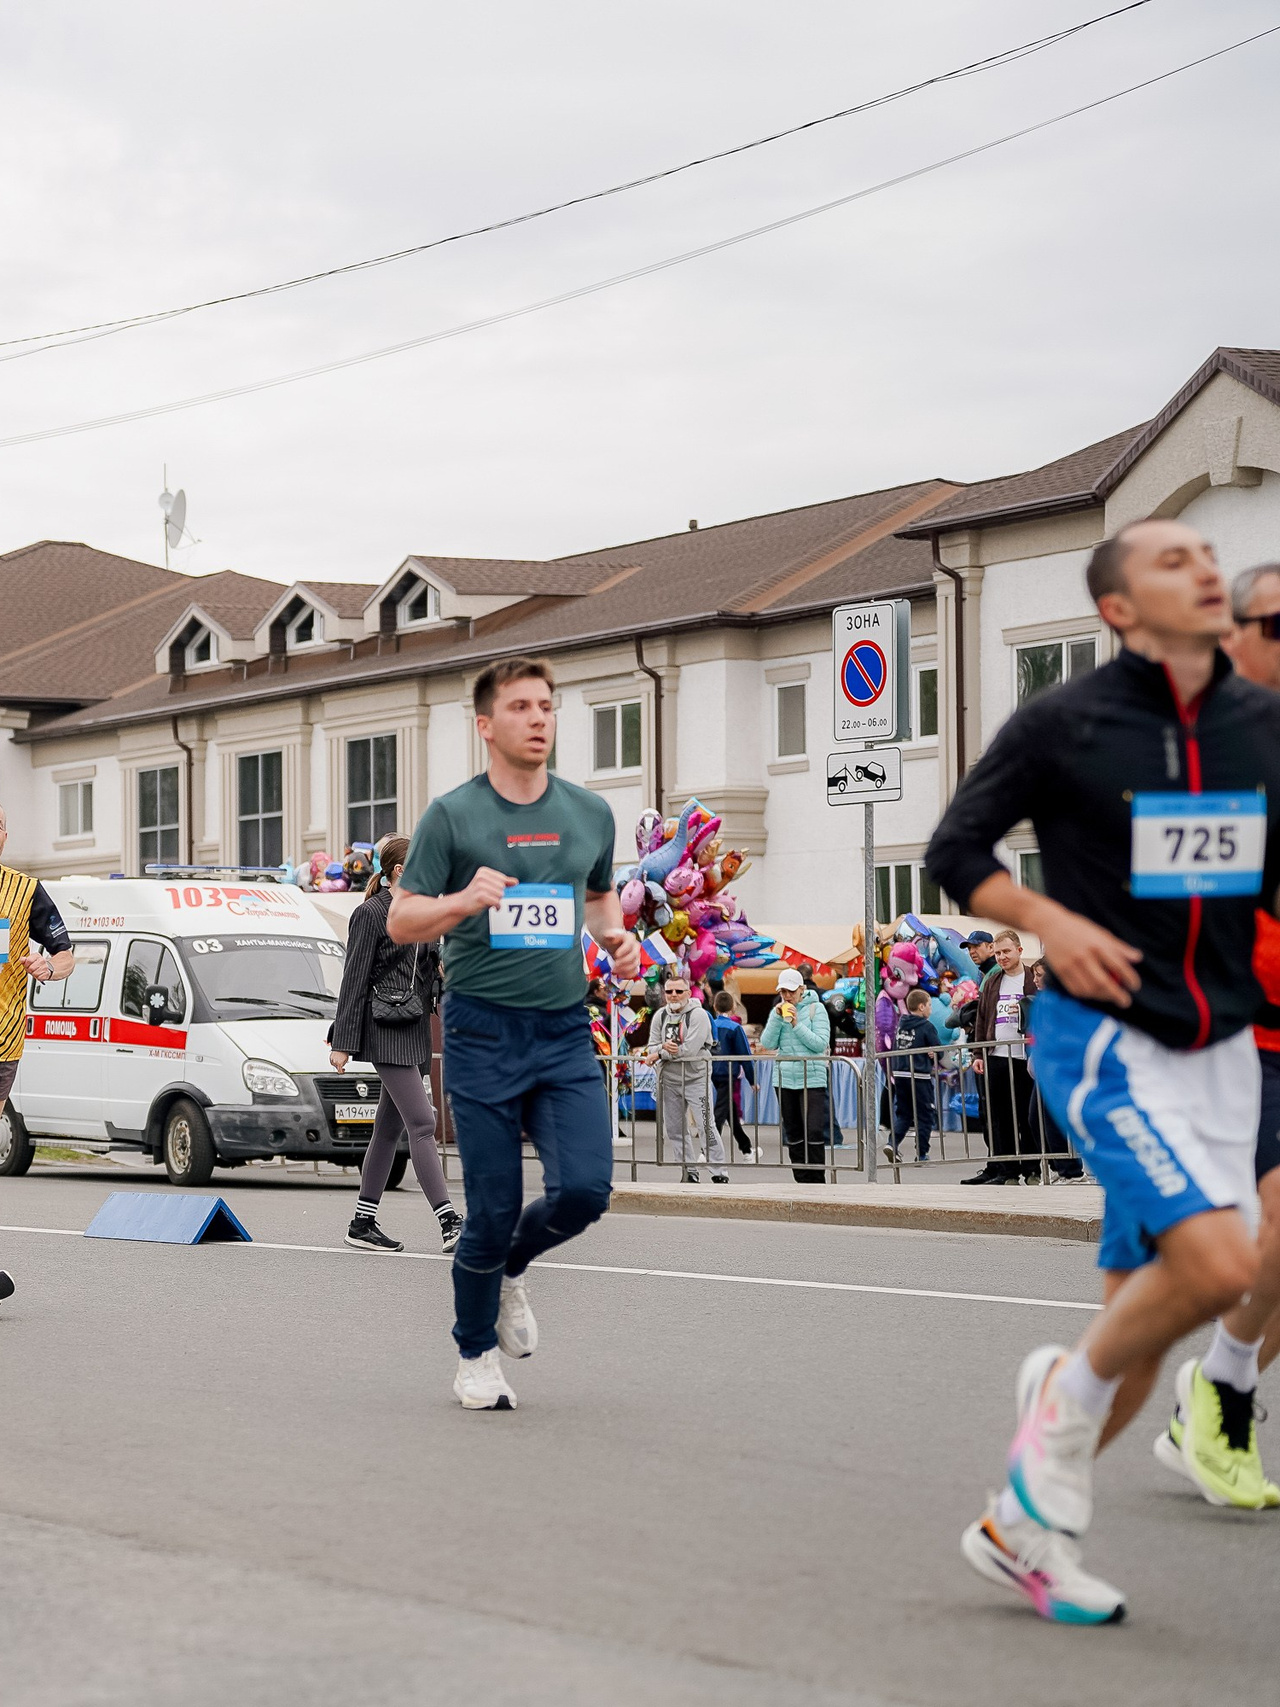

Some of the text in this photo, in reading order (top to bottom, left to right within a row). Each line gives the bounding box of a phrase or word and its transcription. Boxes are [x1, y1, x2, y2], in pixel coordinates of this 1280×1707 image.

[846, 613, 880, 631] ЗОНА
[841, 719, 861, 730] 22.00
[867, 717, 888, 728] 06.00
[1165, 826, 1237, 864] 725
[164, 886, 223, 910] 103
[508, 904, 558, 927] 738
[192, 938, 224, 954] 03
[234, 938, 314, 951] ХАНТЫ-МАНСИЙСК
[316, 940, 344, 957] 03
[44, 1019, 78, 1039] ПОМОЩЬ
